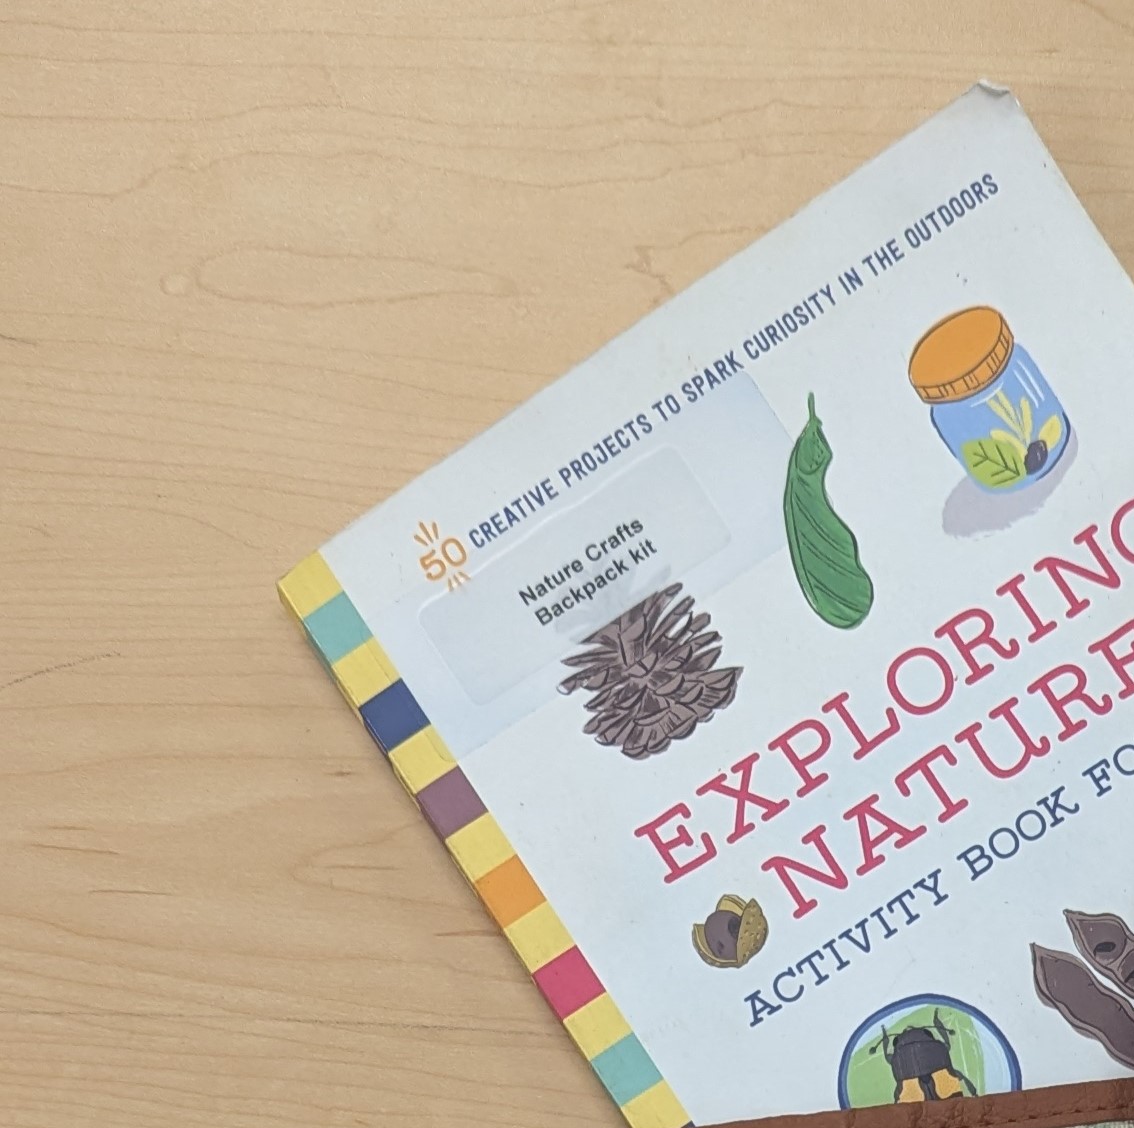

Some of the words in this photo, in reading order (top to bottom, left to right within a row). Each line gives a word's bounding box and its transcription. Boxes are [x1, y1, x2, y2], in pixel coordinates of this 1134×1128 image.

[418, 536, 467, 581] 50
[468, 478, 560, 549] CREATIVE
[558, 413, 653, 489] PROJECTS
[651, 394, 682, 422] TO
[681, 350, 745, 404] SPARK
[742, 284, 837, 361] CURIOSITY
[838, 267, 864, 295] IN
[861, 238, 905, 277] THE
[904, 173, 999, 249] OUTDOORS
[518, 559, 584, 606] Nature
[585, 519, 644, 562] Crafts
[534, 559, 630, 626] Backpack
[627, 539, 658, 565] kit
[743, 868, 949, 1028] ACTIVITY
[956, 785, 1080, 882] BOOK
